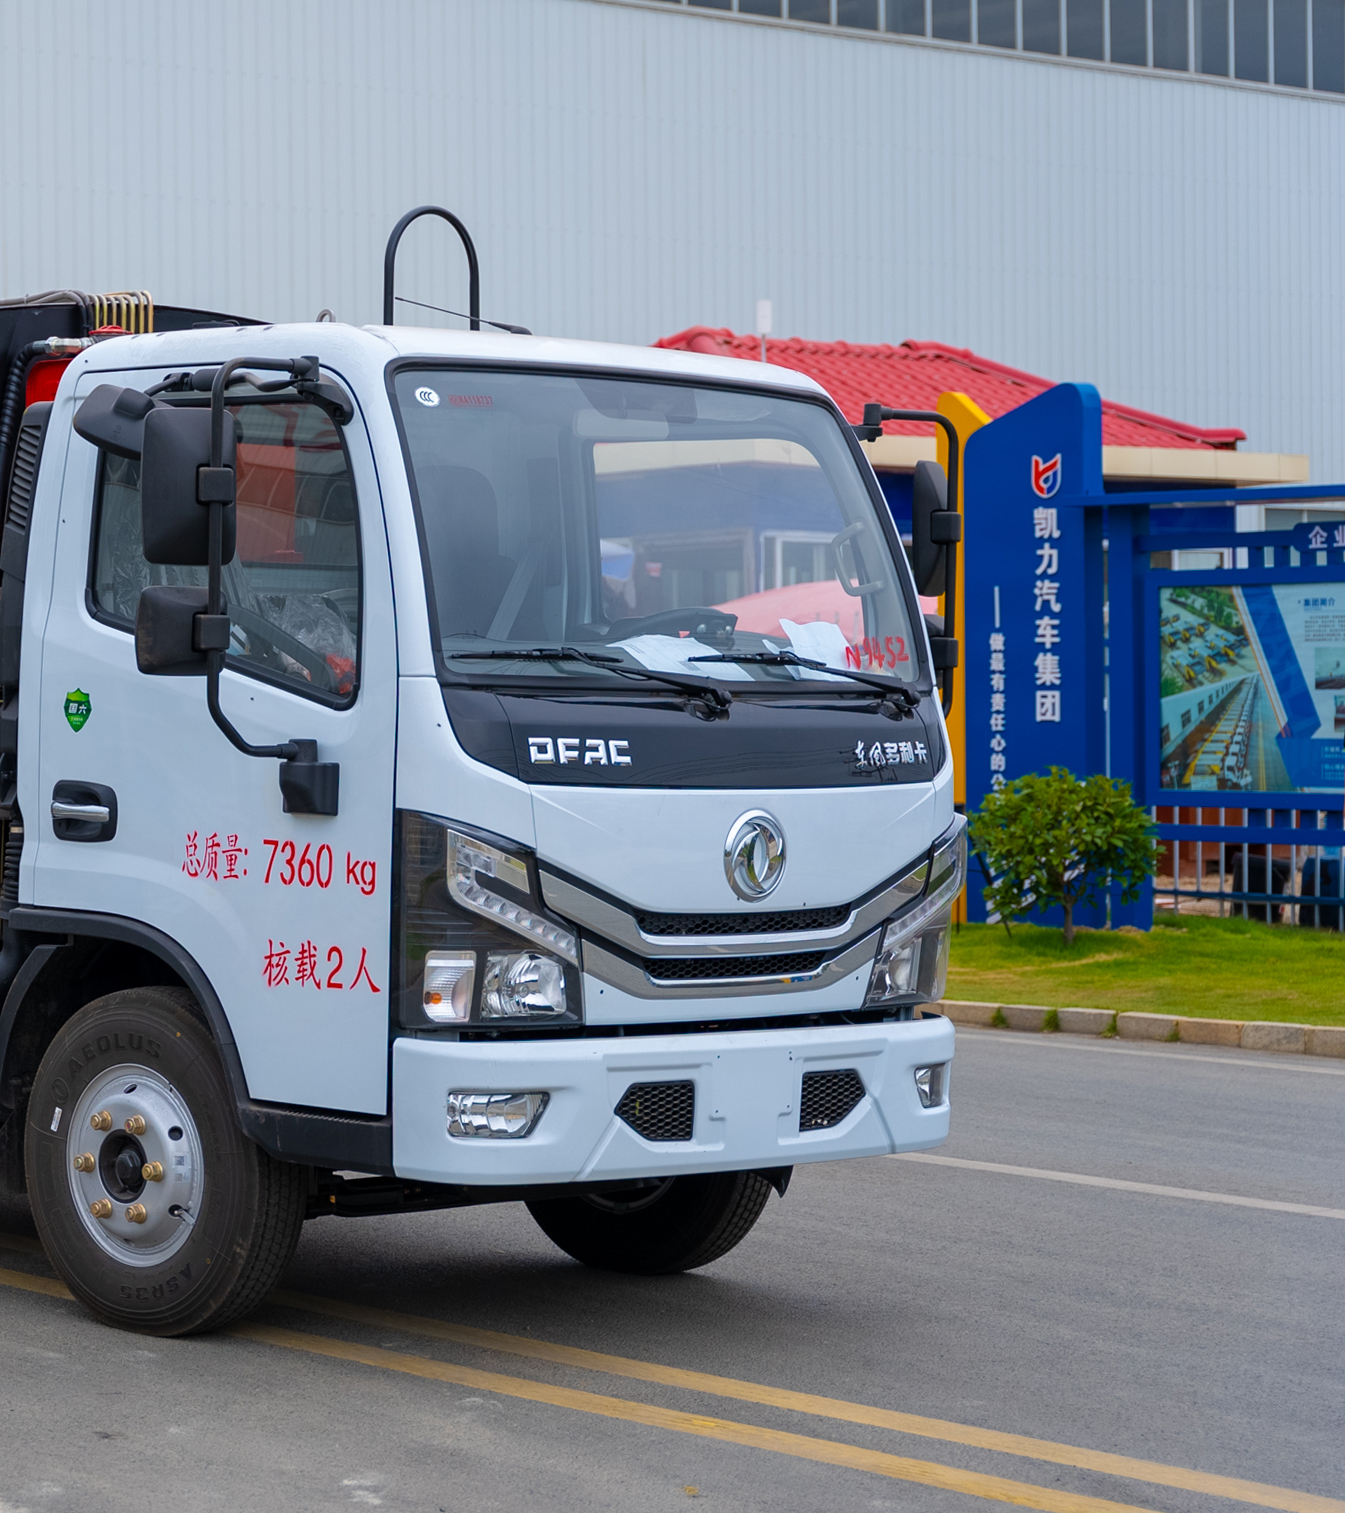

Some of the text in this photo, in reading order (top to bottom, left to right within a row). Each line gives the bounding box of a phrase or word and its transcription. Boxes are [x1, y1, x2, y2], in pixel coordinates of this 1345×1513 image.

[1033, 506, 1061, 722] 凯力汽车集团
[845, 636, 909, 670] N9452
[527, 737, 632, 766] DFAC
[263, 839, 333, 888] 7360
[346, 851, 376, 895] kg
[262, 938, 381, 993] 核载2人
[67, 1032, 162, 1080] AEOLUS
